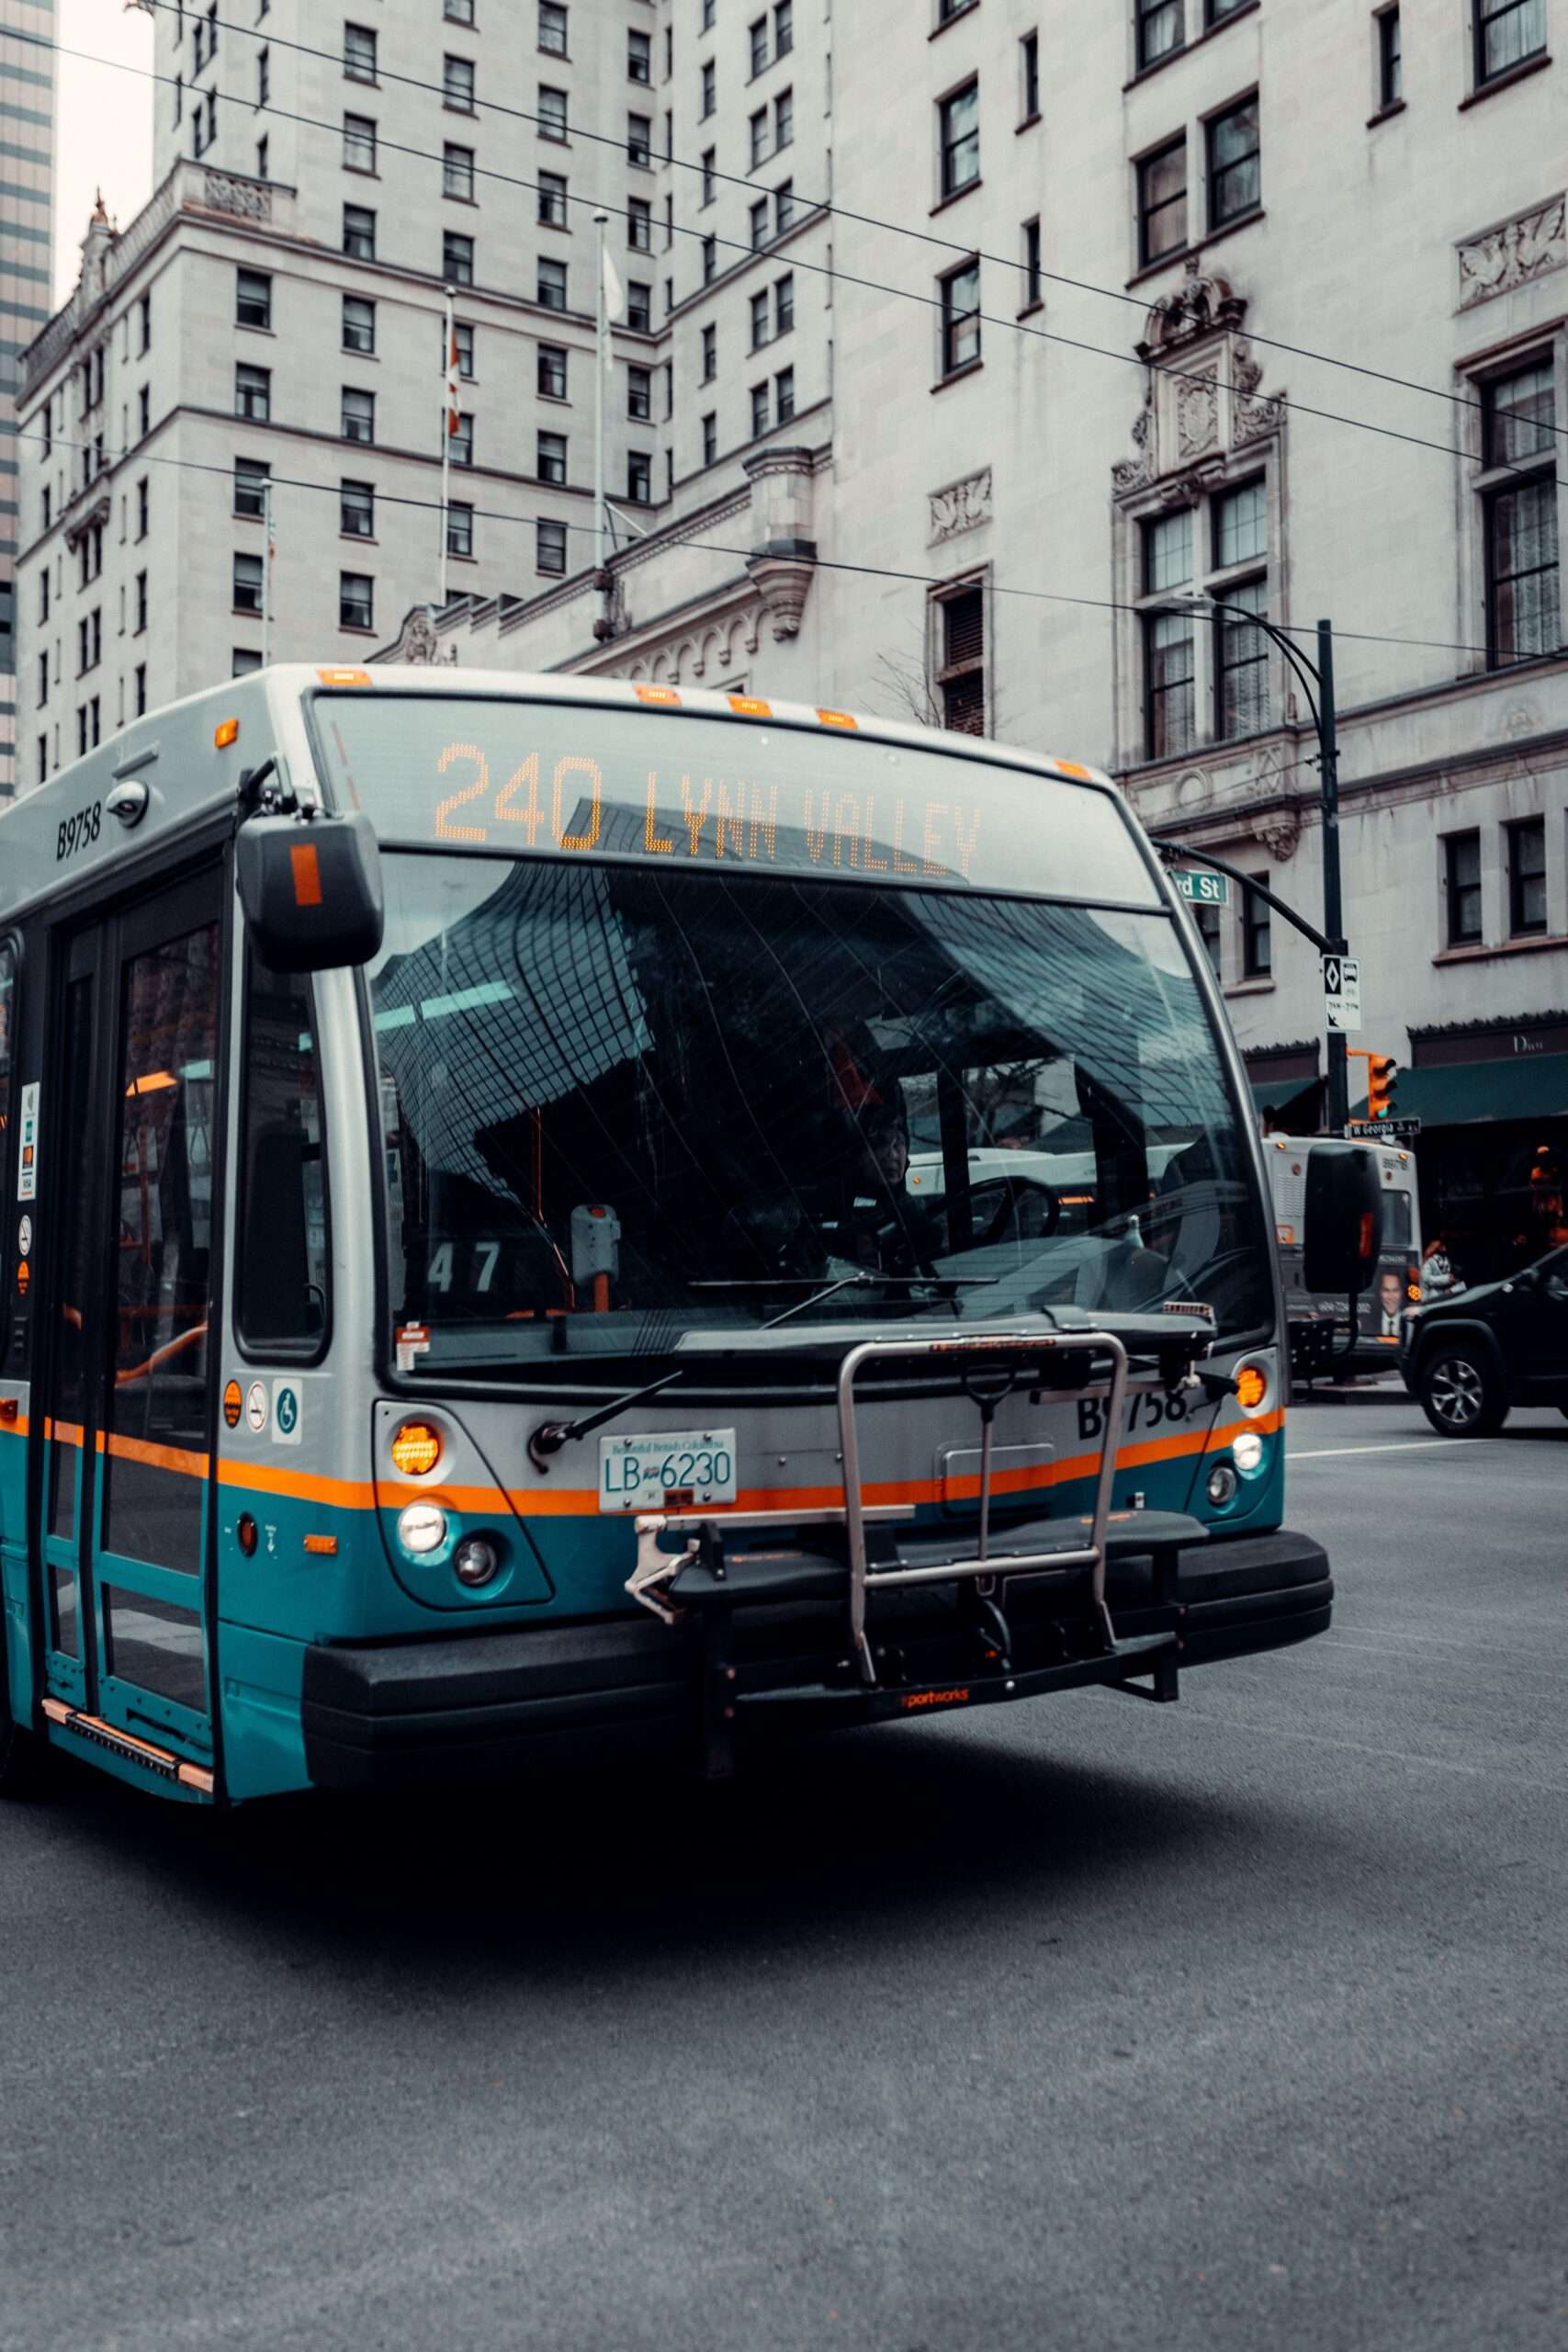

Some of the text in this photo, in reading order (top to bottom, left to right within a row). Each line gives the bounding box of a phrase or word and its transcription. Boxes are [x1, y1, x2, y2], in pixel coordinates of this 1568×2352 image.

[57, 800, 101, 861] B9758
[435, 743, 981, 877] 240 LYNN VALLEY
[1200, 876, 1220, 899] St
[605, 1451, 731, 1492] LB 6230
